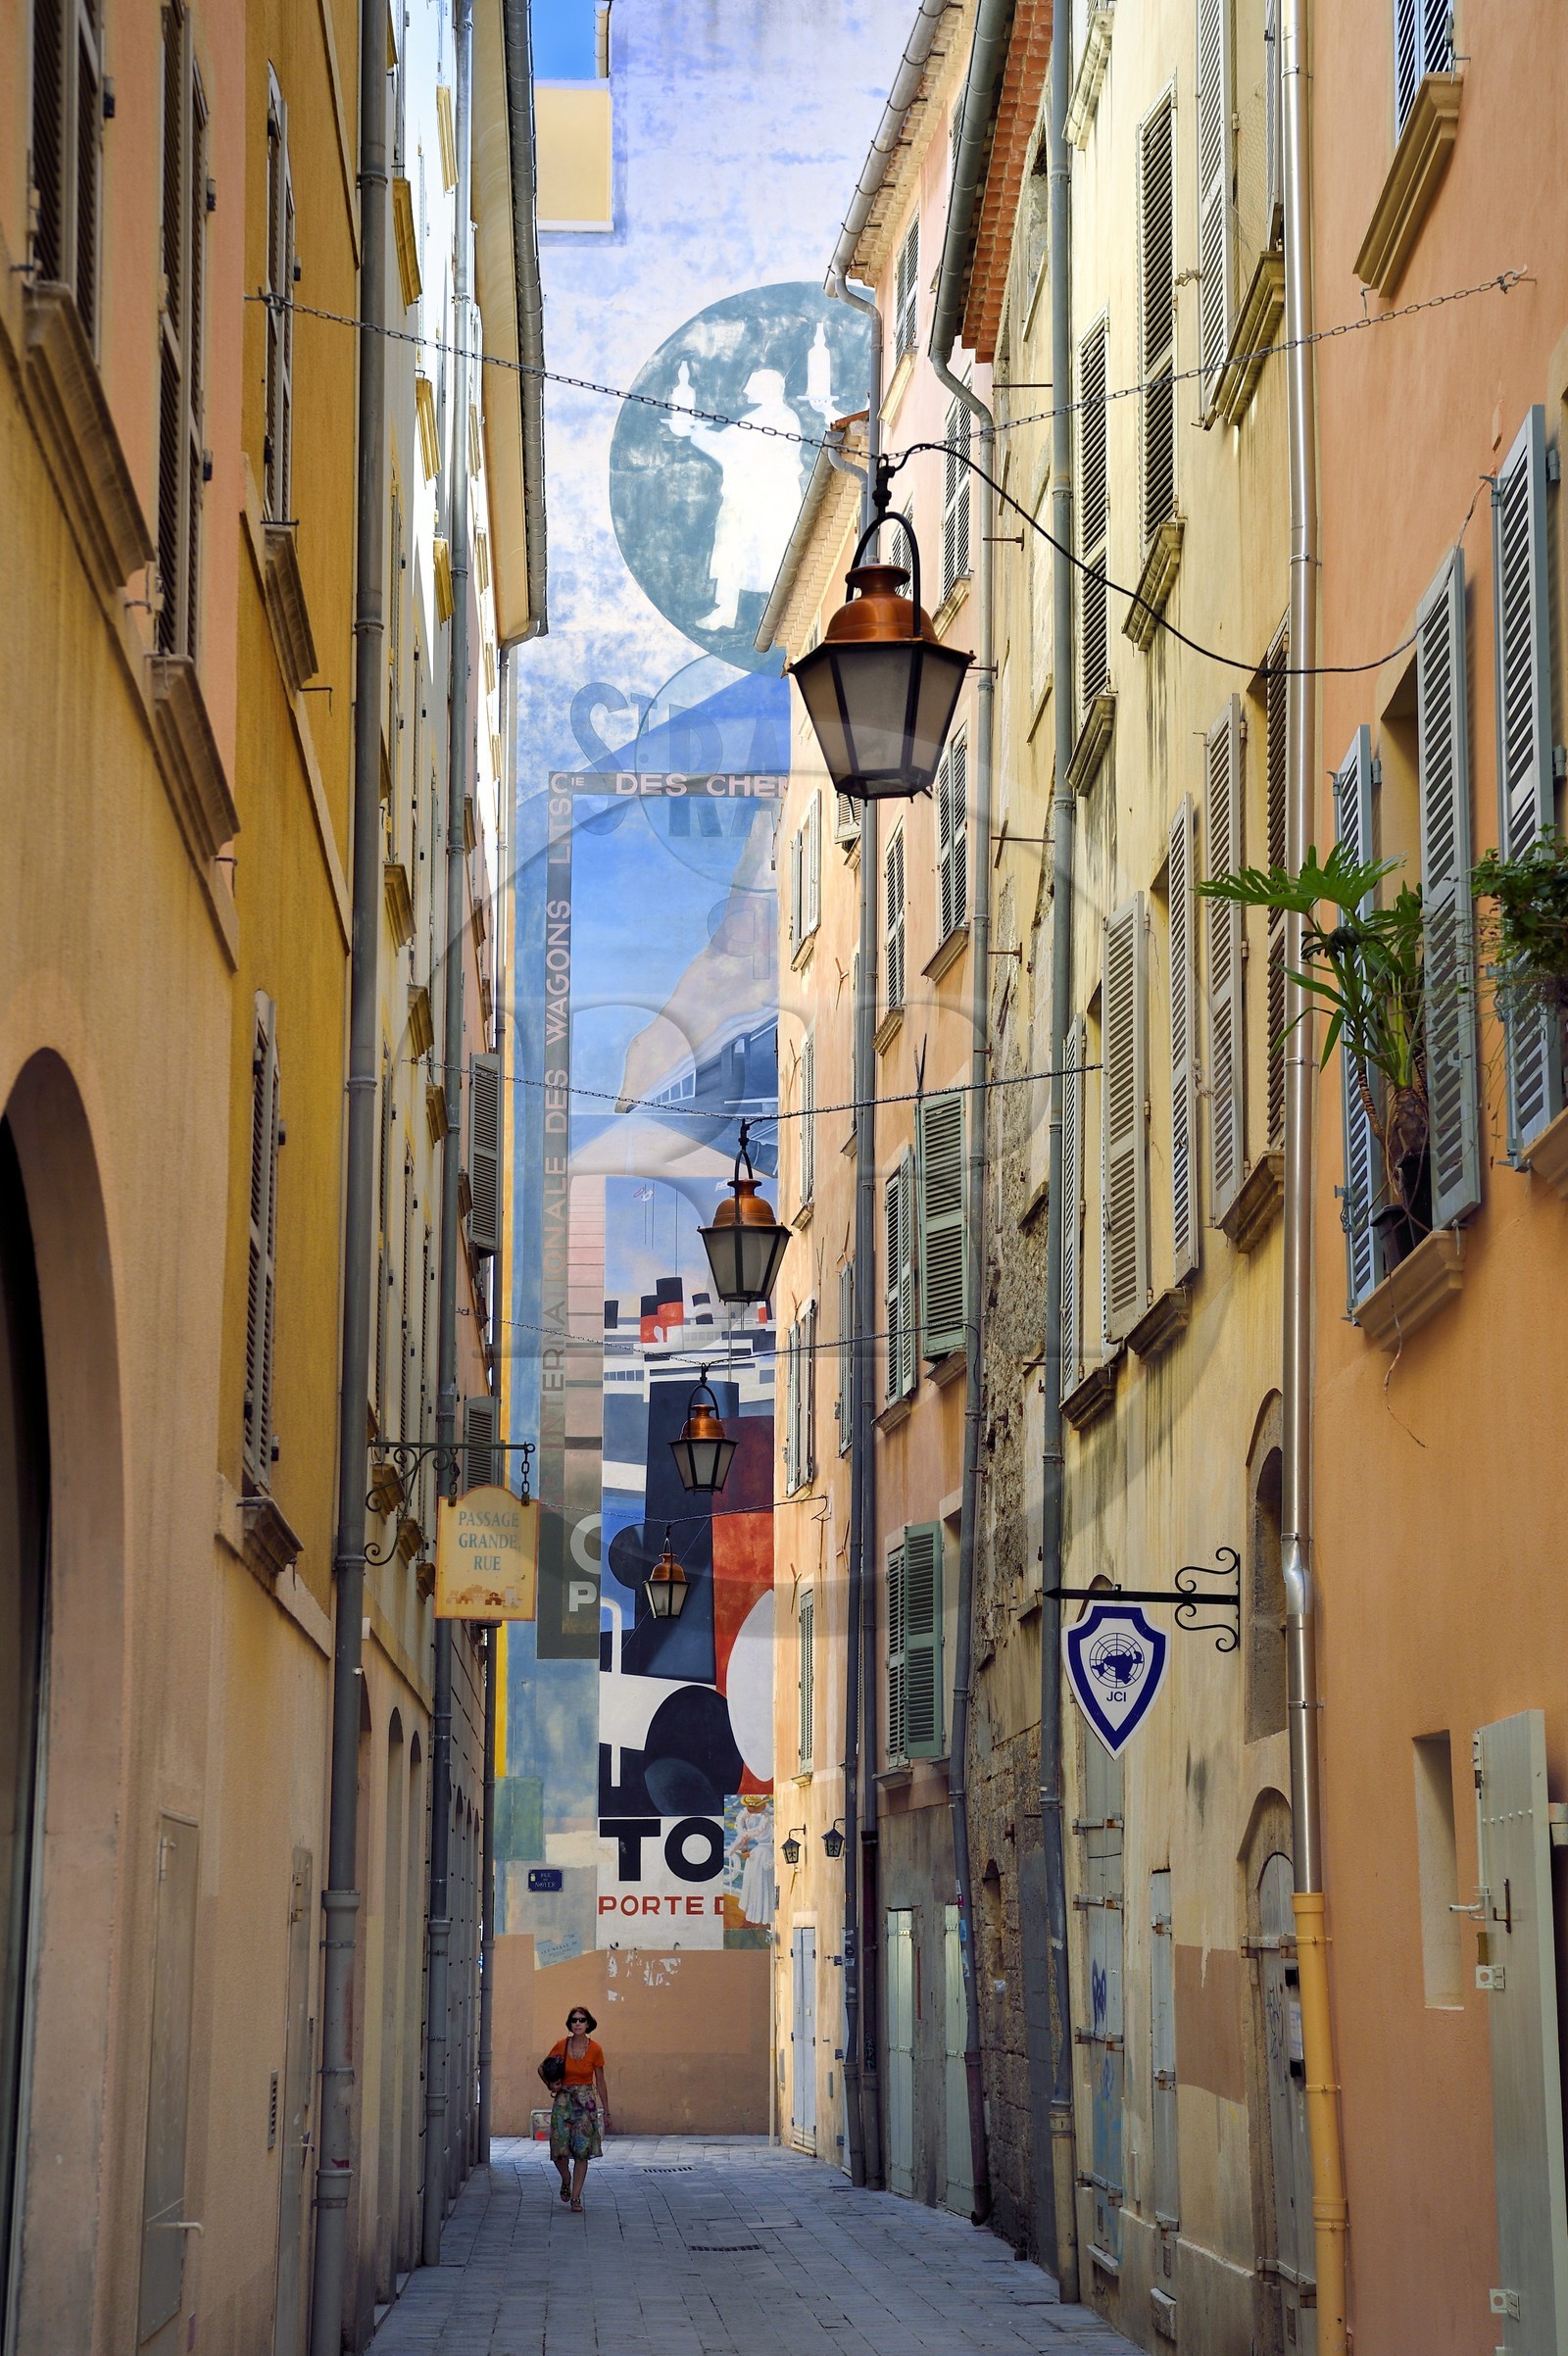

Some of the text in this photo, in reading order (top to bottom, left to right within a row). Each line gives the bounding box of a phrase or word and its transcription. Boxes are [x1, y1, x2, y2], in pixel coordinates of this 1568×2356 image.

[615, 772, 688, 796] DES
[549, 797, 571, 864] LITS
[546, 900, 571, 1046] WAGONS
[545, 1069, 569, 1134] DES
[458, 1511, 519, 1527] PASSAGE
[459, 1533, 517, 1549] GRANDE
[473, 1555, 501, 1570] RUE
[1106, 1692, 1127, 1702] JCI
[600, 1817, 725, 1883] TO
[598, 1895, 705, 1916] PORTE
